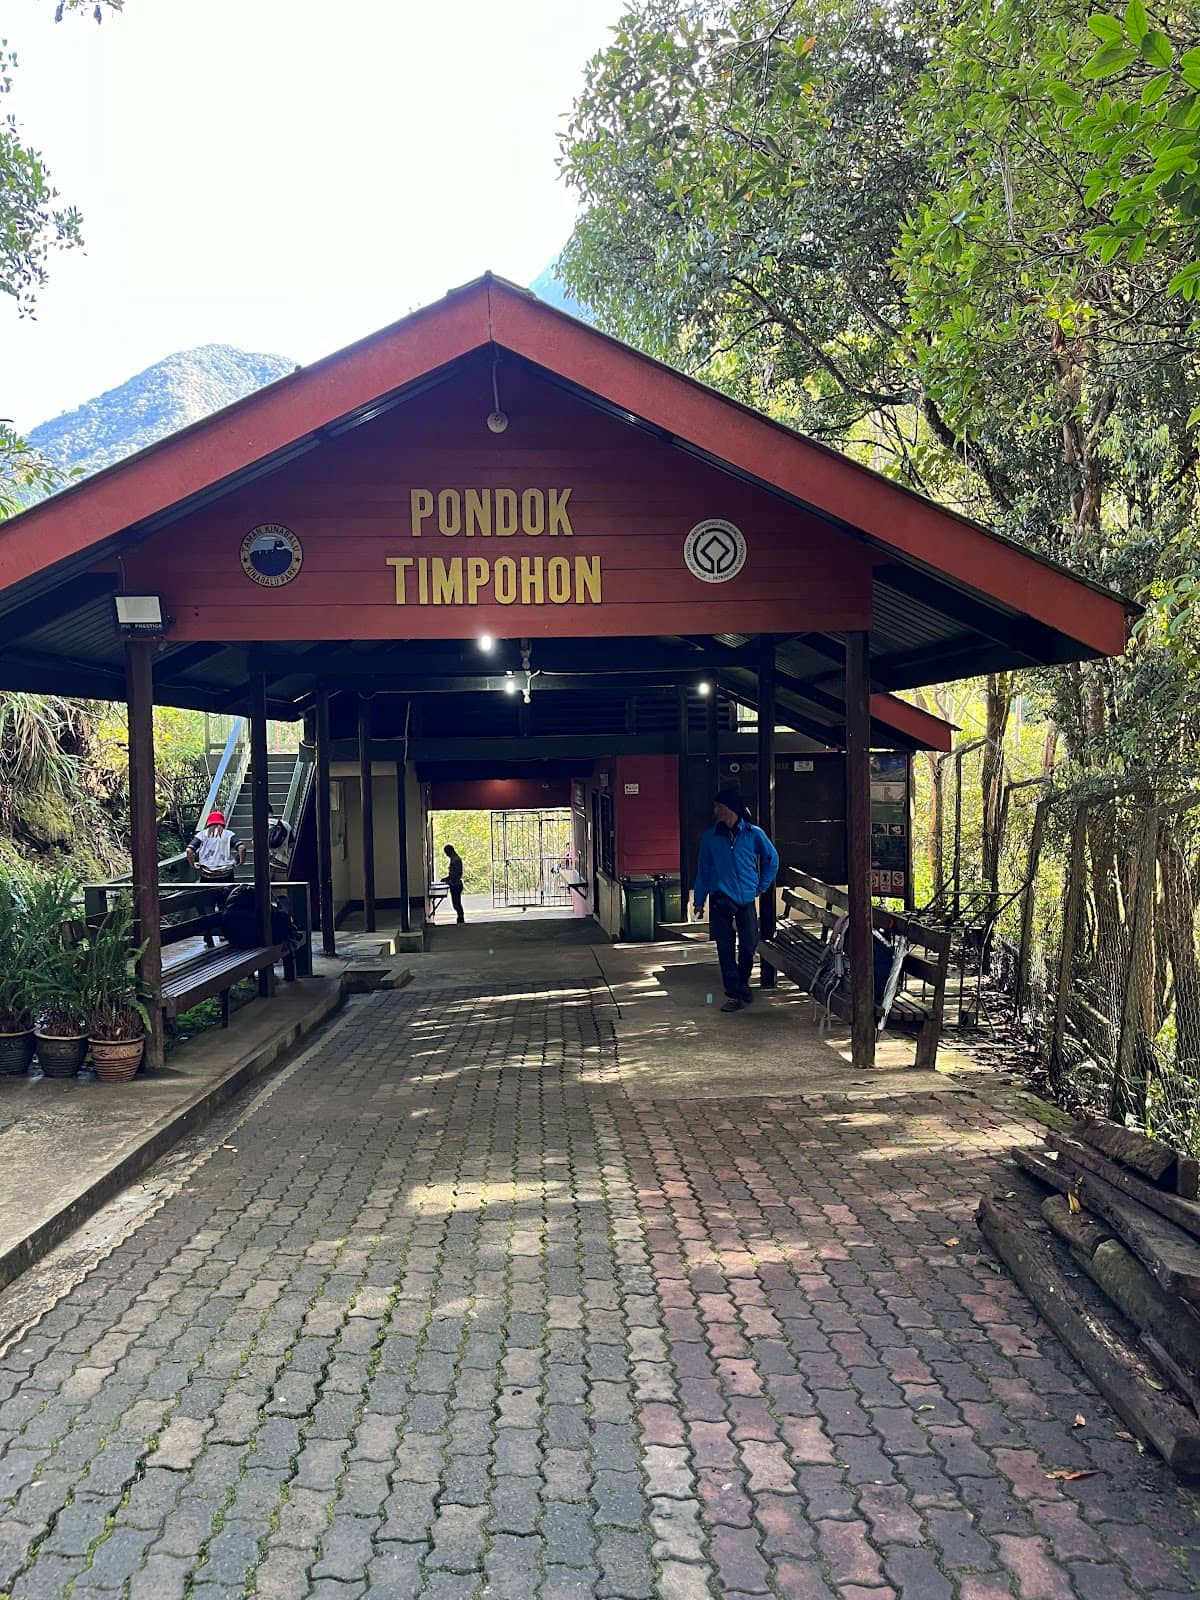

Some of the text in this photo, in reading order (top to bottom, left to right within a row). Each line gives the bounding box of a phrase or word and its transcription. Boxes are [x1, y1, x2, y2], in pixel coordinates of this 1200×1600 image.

[410, 488, 573, 537] PONDOK
[241, 525, 301, 552] TAMAN KINABALU
[245, 566, 297, 585] KINABALU PARK
[386, 556, 603, 605] TIMPOHON
